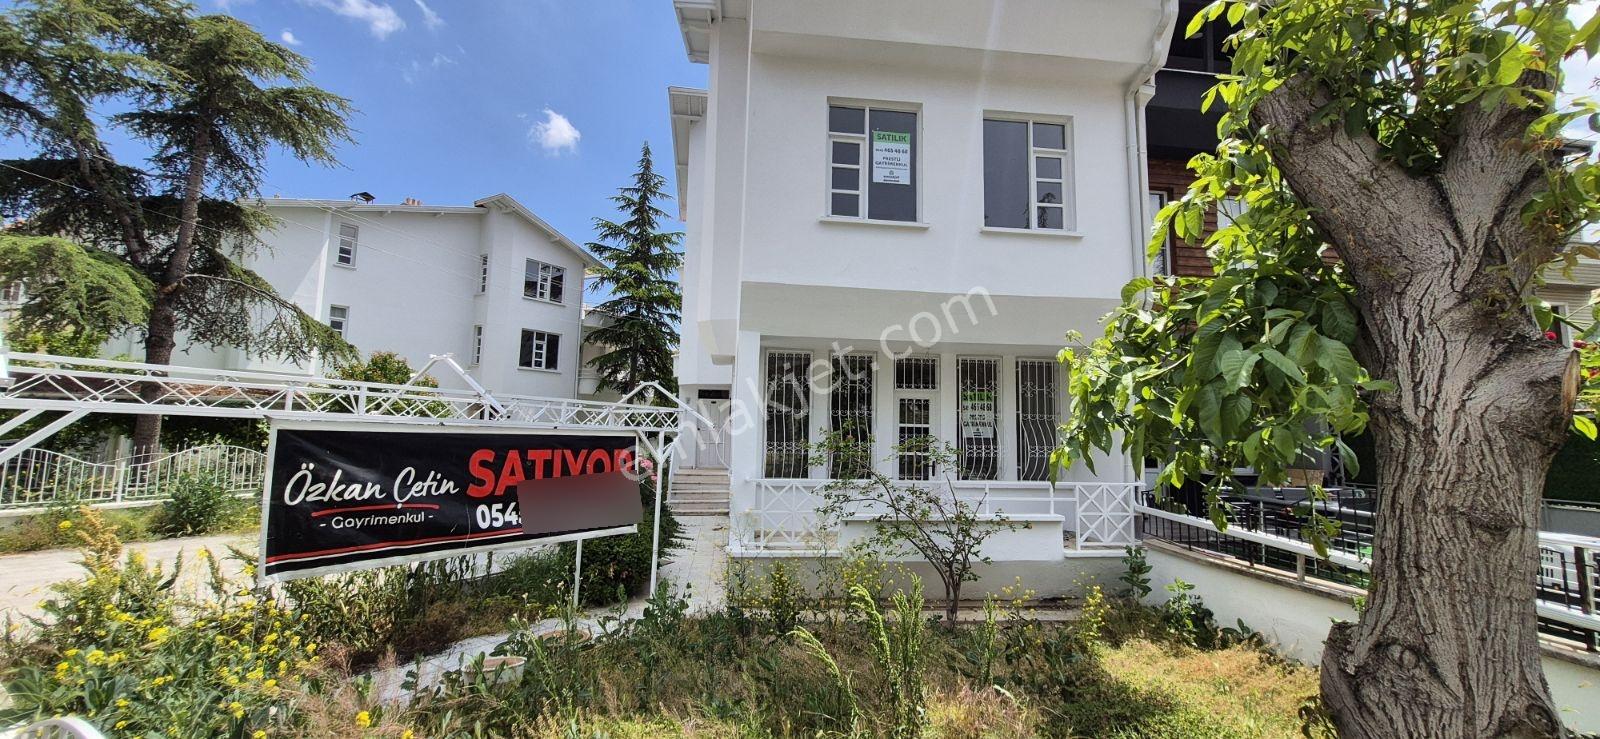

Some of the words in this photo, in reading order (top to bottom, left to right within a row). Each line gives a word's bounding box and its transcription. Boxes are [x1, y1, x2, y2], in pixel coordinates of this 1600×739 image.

[876, 133, 907, 143] SATILIK
[284, 462, 387, 506] Özkan
[393, 466, 460, 509] Çetin
[331, 511, 425, 529] Gayrimenkul
[476, 502, 523, 530] 054
